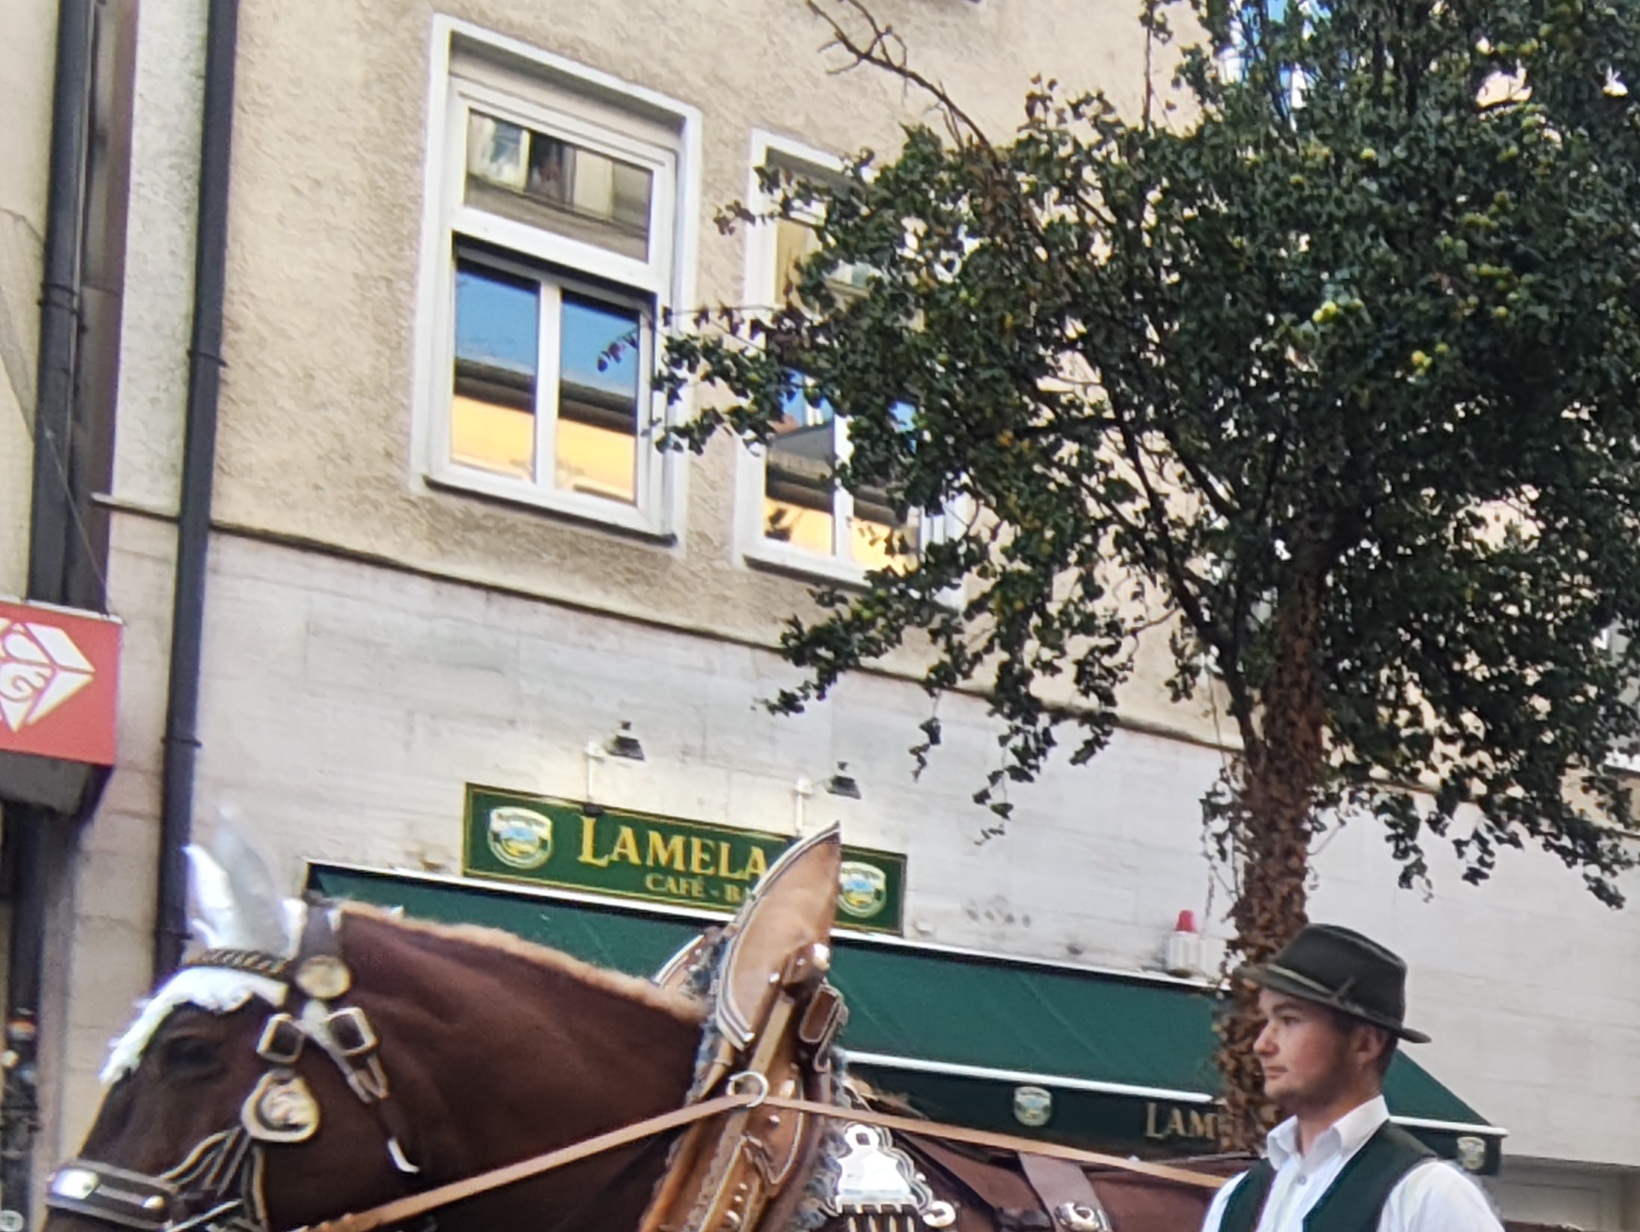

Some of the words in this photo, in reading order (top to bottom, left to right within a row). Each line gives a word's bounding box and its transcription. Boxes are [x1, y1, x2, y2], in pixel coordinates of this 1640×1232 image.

[645, 872, 704, 899] CAFÉ
[724, 882, 756, 903] B
[1145, 1101, 1219, 1141] LAM
